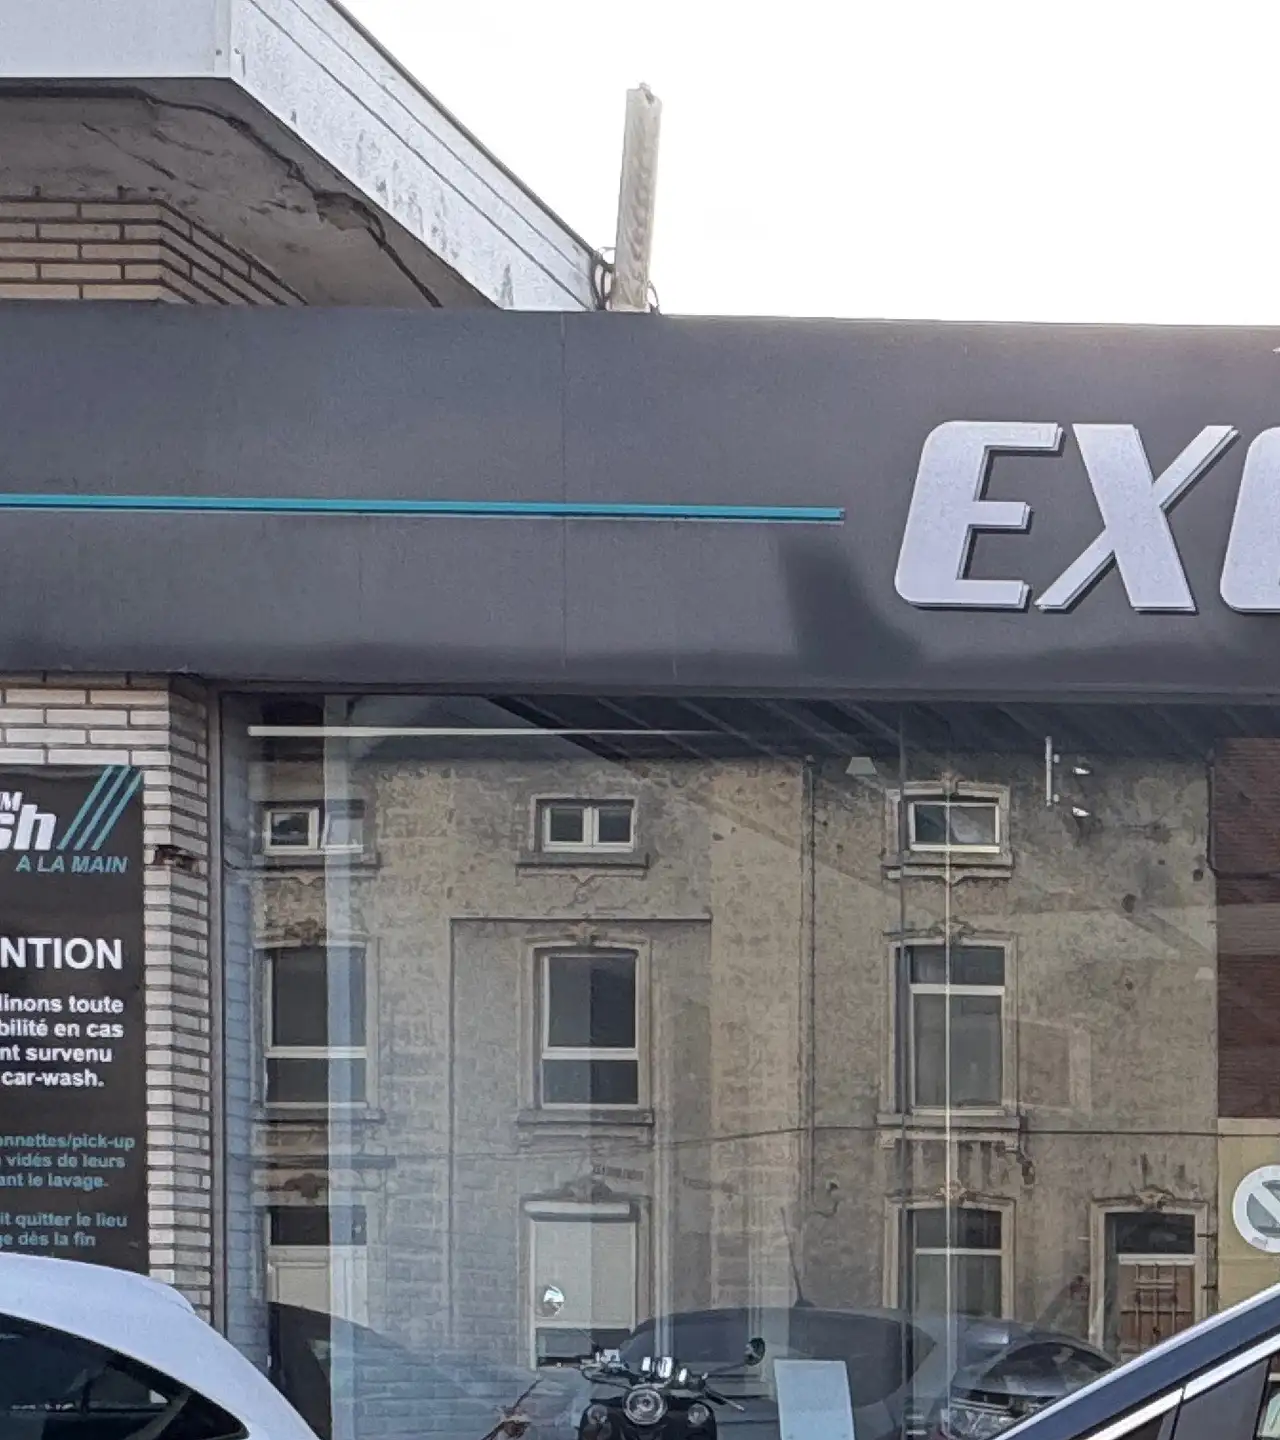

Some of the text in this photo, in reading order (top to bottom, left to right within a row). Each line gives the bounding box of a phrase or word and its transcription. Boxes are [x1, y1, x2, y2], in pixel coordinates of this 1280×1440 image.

[15, 854, 128, 873] A LA MAIN
[0, 937, 122, 970] NTION
[68, 995, 124, 1014] toute
[54, 1022, 81, 1038] en
[86, 1023, 124, 1038] cas
[25, 1048, 113, 1063] survenu
[1, 1068, 105, 1087] car-wash.
[0, 1133, 136, 1151] nnettes/pick-up
[57, 1153, 78, 1168] de
[82, 1153, 126, 1168] leurs
[28, 1172, 43, 1187] le
[48, 1172, 109, 1191] lavage.
[15, 1212, 72, 1228] quitter
[76, 1212, 92, 1227] le
[96, 1212, 128, 1227] lieu
[54, 1231, 69, 1246] la
[73, 1231, 96, 1247] fin
